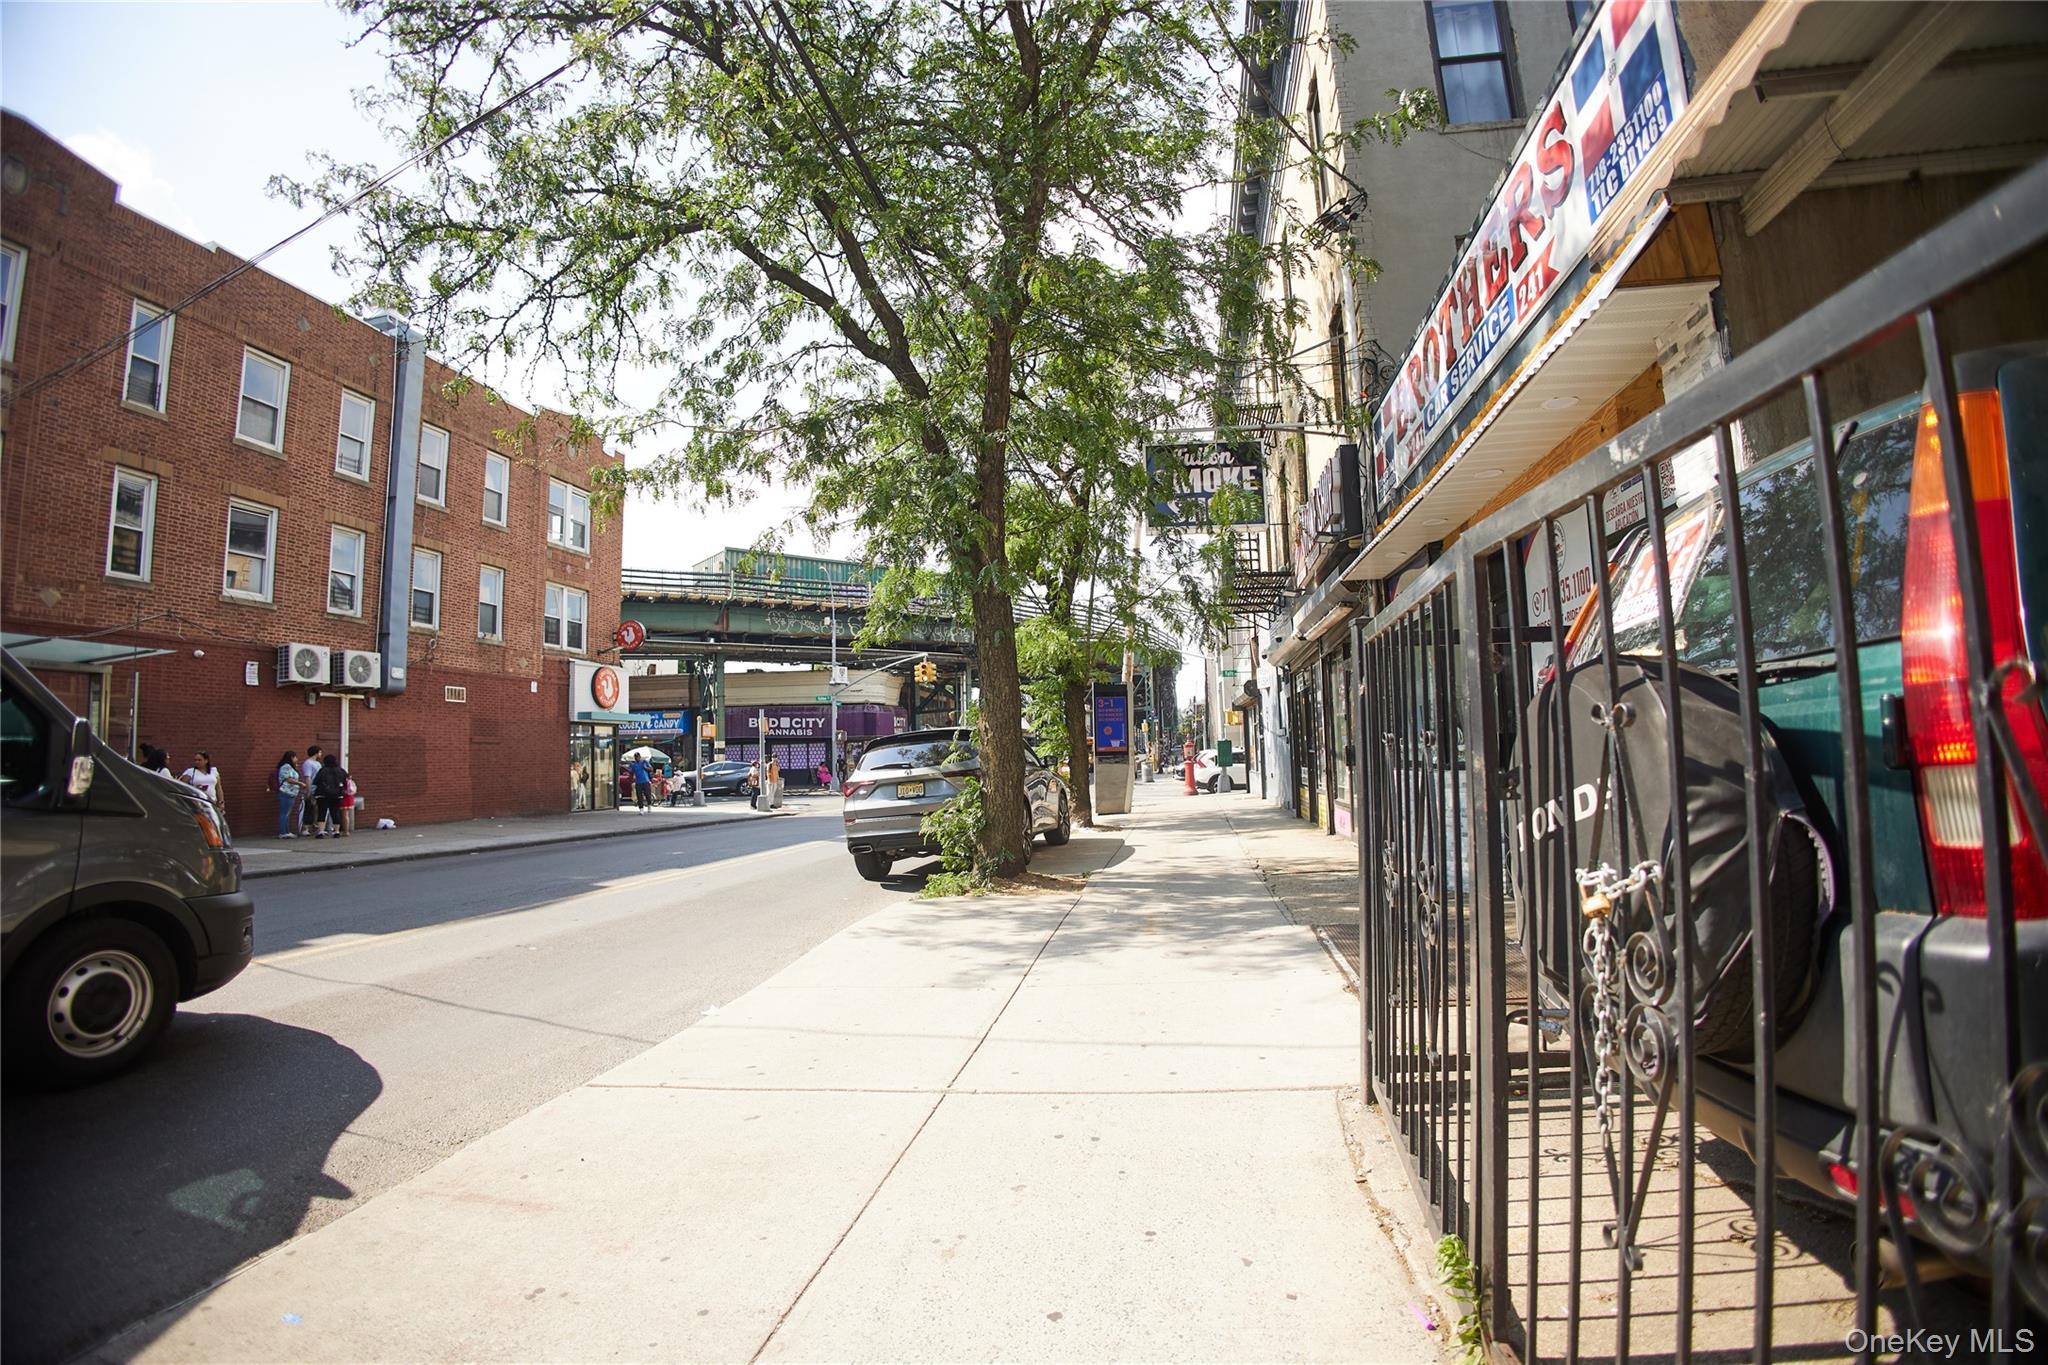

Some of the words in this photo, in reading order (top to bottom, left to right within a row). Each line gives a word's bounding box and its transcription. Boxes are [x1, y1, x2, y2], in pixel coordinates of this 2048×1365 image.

[1588, 80, 1663, 196] 718-2351100
[1591, 168, 1619, 216] TLC
[1426, 382, 1449, 428] CAR
[1450, 294, 1511, 396] SERVICE
[1518, 262, 1545, 315] 241
[1174, 447, 1235, 467] ulon
[1153, 465, 1260, 494] MOKE
[1541, 565, 1592, 612] 7135.1100
[654, 719, 680, 729] CANDY
[748, 717, 779, 728] BD
[791, 717, 825, 728] CITY
[768, 728, 813, 736] ANNABIS
